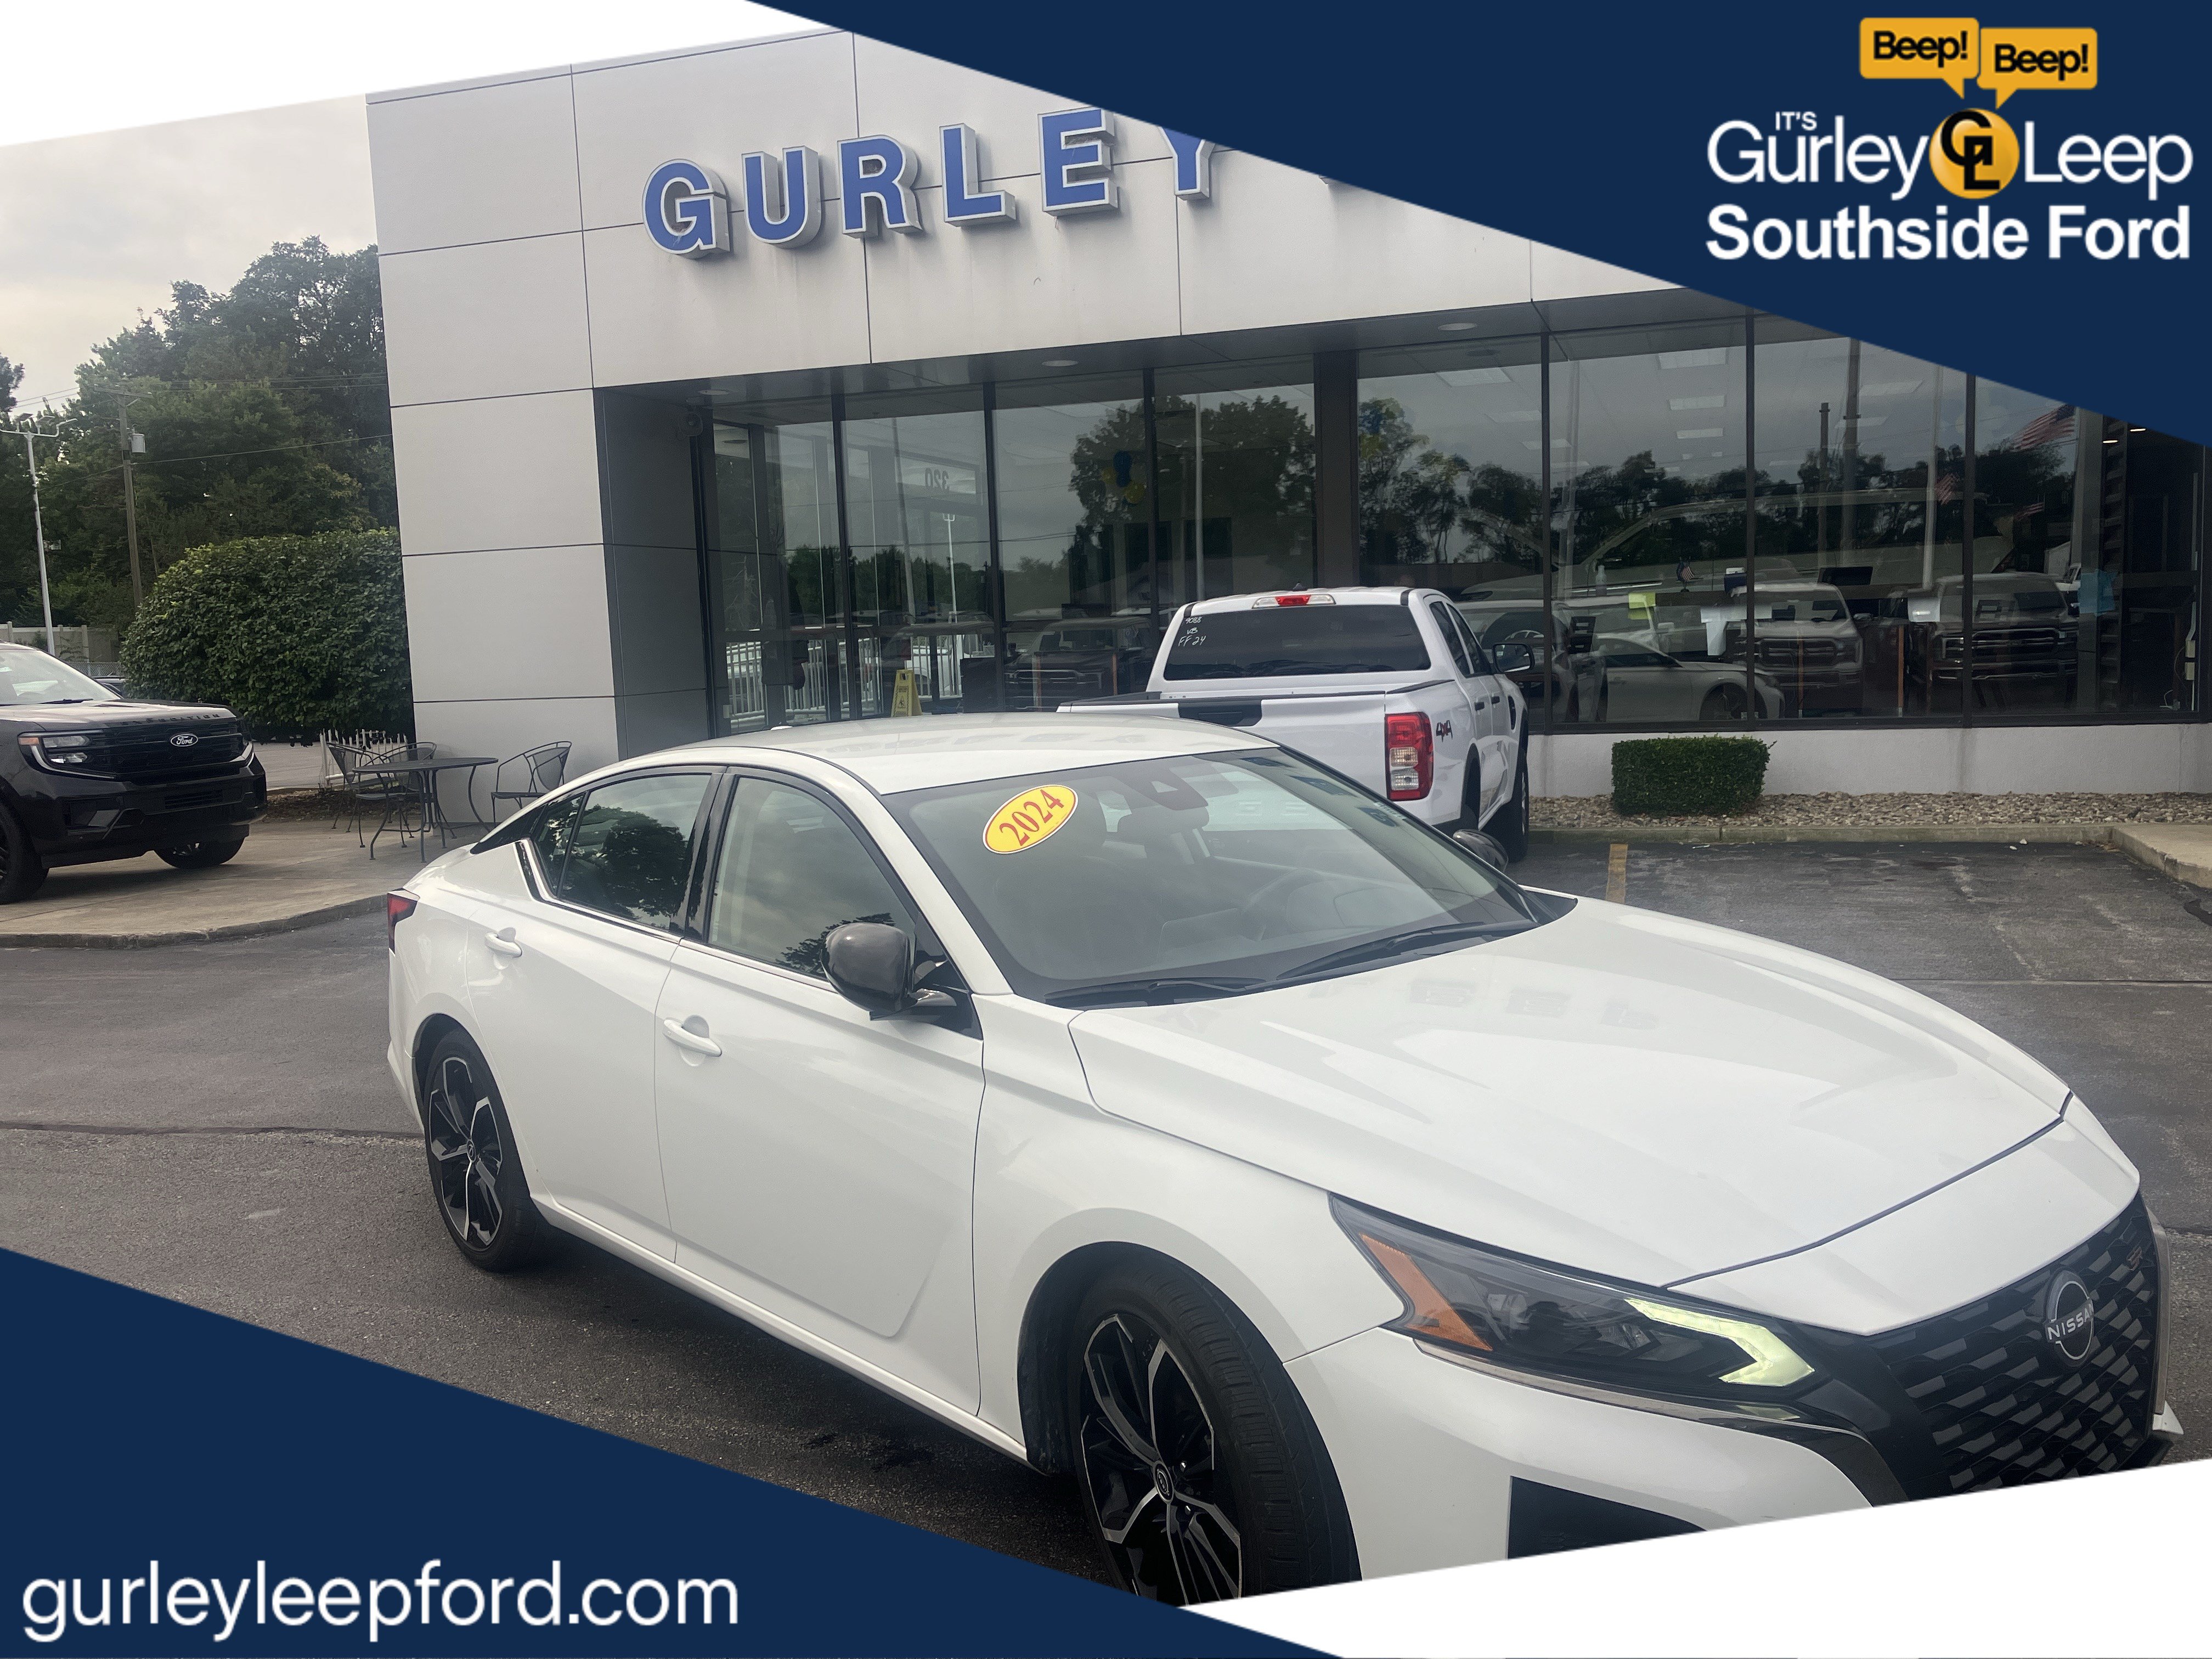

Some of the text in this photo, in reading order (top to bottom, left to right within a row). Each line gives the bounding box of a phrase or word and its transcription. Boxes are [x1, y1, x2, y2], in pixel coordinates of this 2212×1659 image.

[642, 106, 1218, 258] GURLEY
[176, 736, 193, 745] Ford
[999, 789, 1064, 846] 2024
[2047, 1304, 2094, 1340] NISSAN
